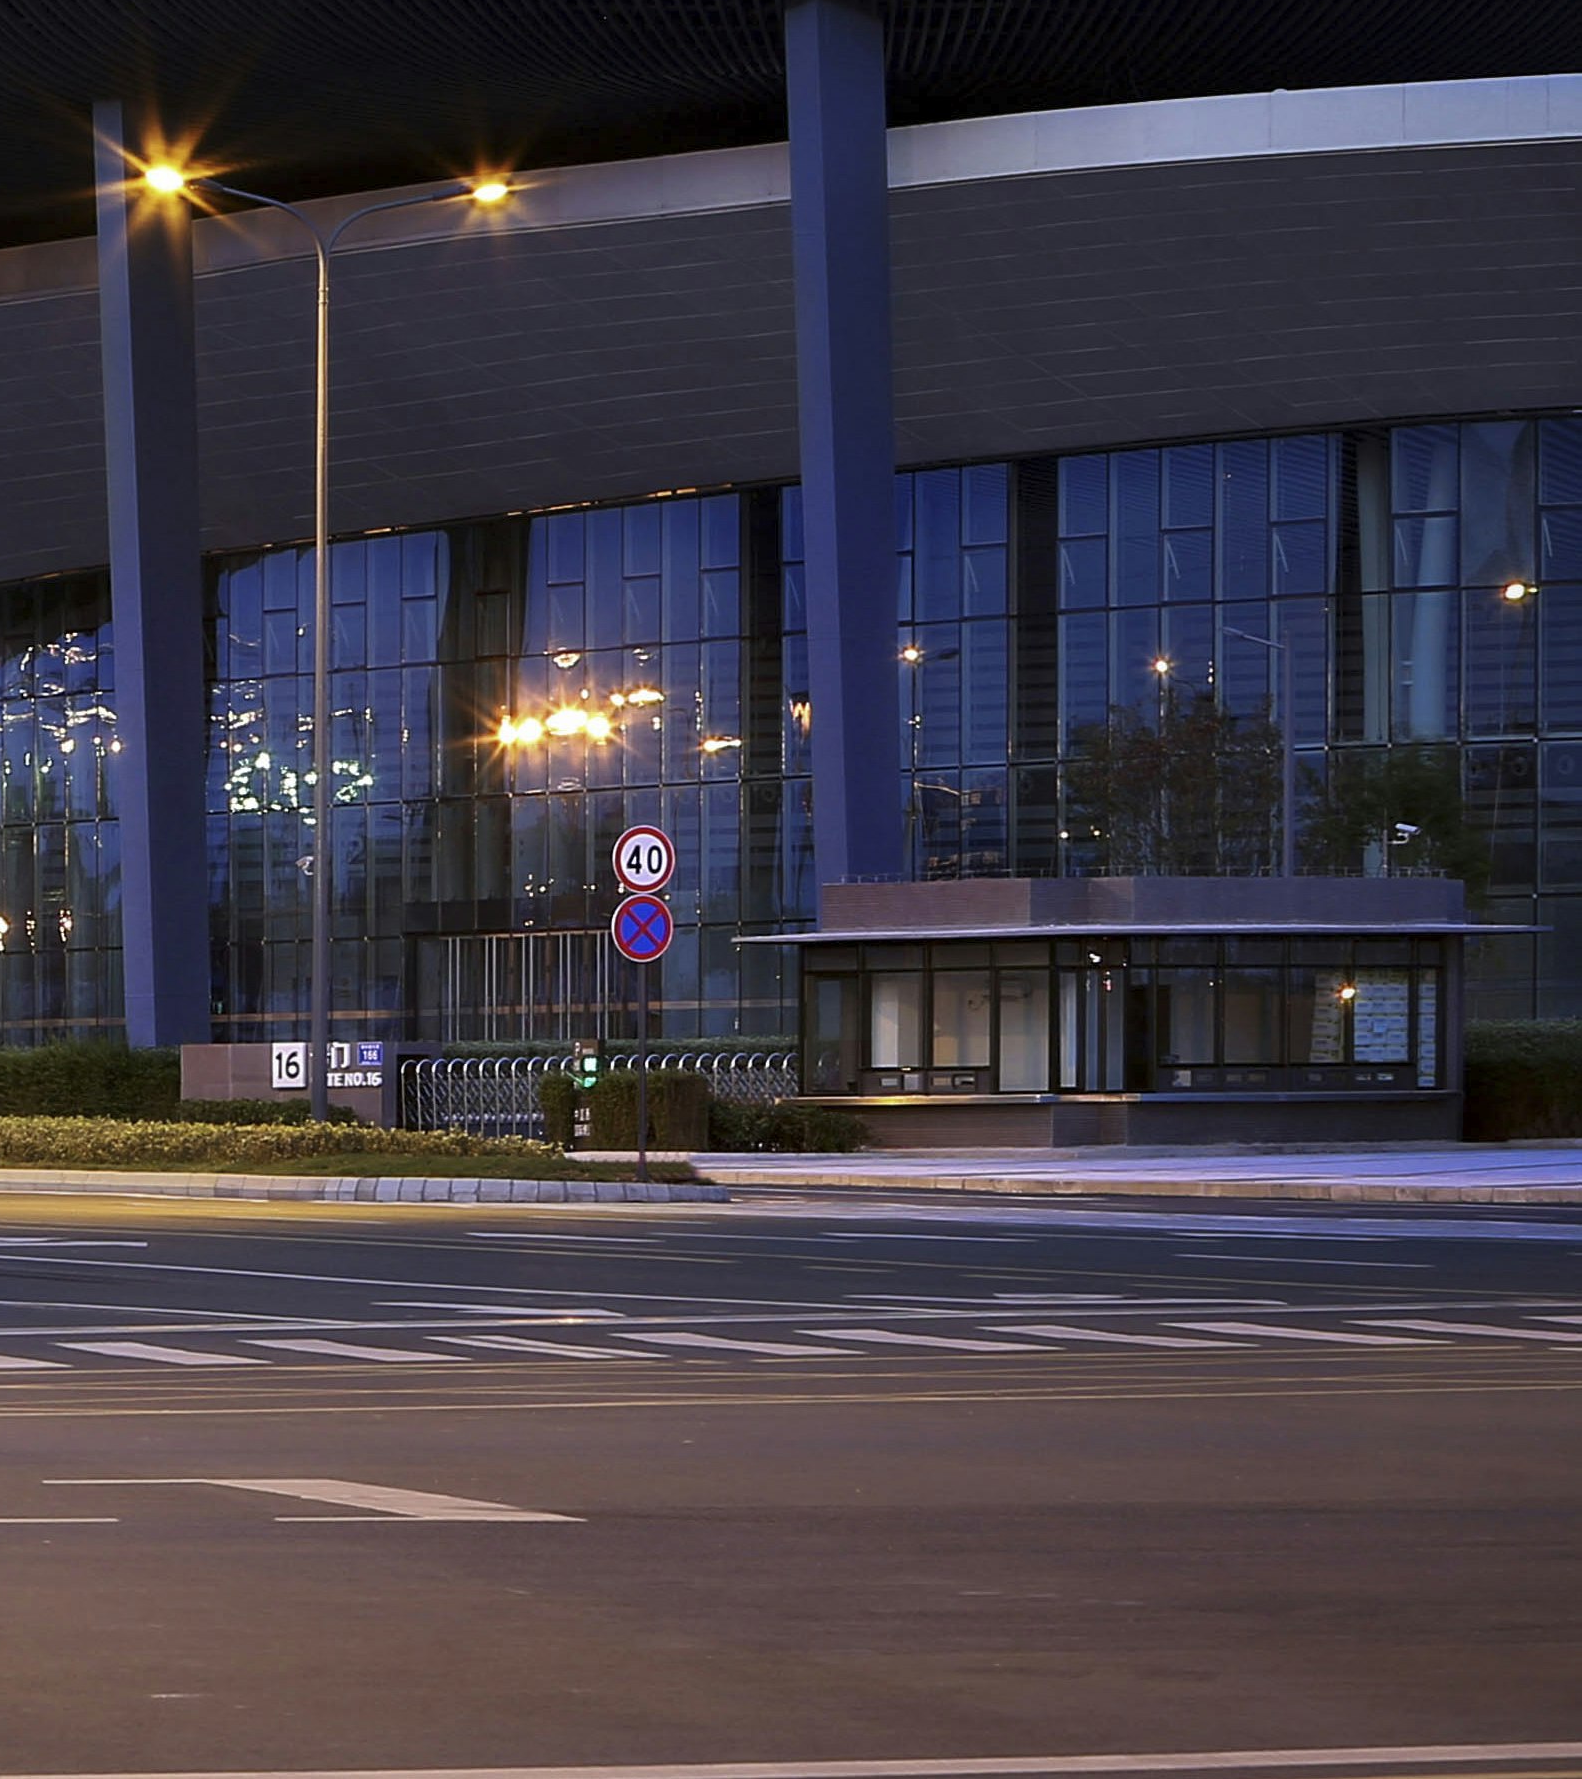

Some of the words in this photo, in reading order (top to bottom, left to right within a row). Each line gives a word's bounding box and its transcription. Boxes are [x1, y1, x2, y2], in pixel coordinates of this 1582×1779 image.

[626, 844, 663, 875] 40
[275, 1051, 301, 1079] 16
[326, 1041, 351, 1069] 门
